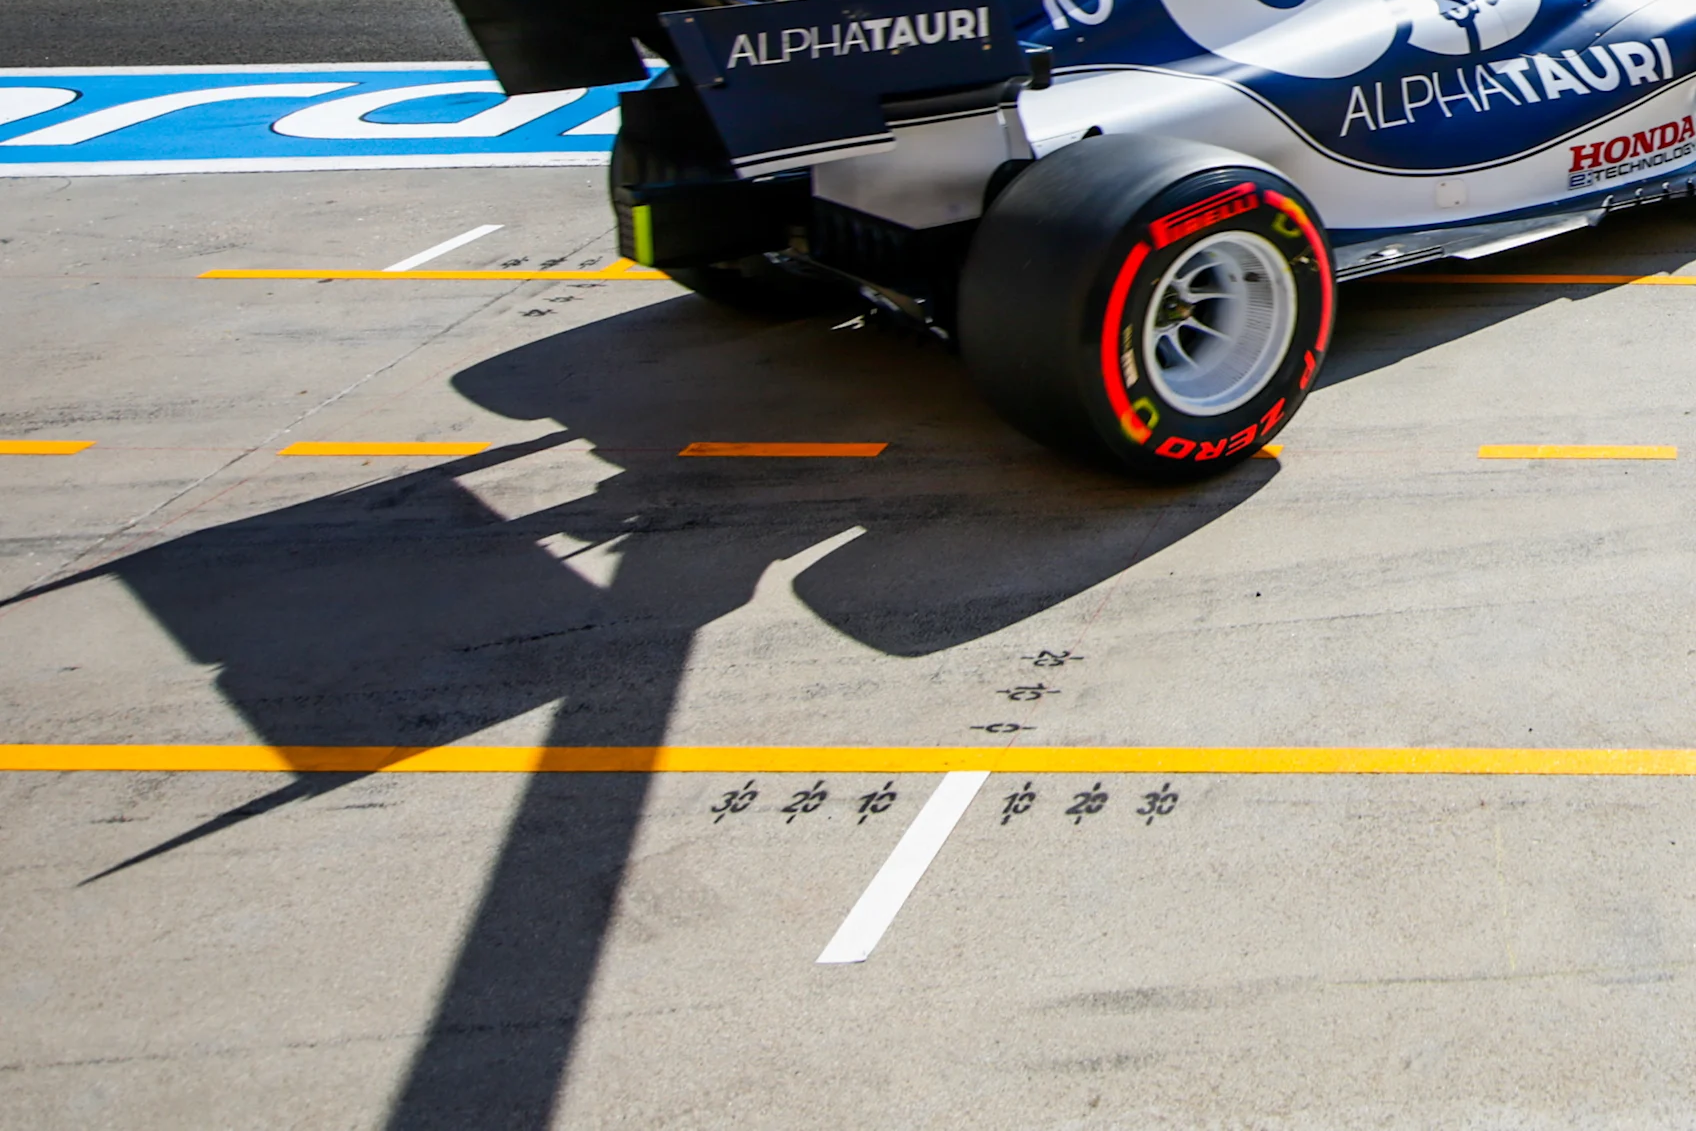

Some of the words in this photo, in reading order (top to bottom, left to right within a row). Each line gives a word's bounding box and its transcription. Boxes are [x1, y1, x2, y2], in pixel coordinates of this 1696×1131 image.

[727, 6, 989, 69] ALPHATAURI
[1339, 38, 1675, 137] ALPHATAURI
[1568, 115, 1696, 172] HONDA
[1155, 397, 1287, 461] ZERO
